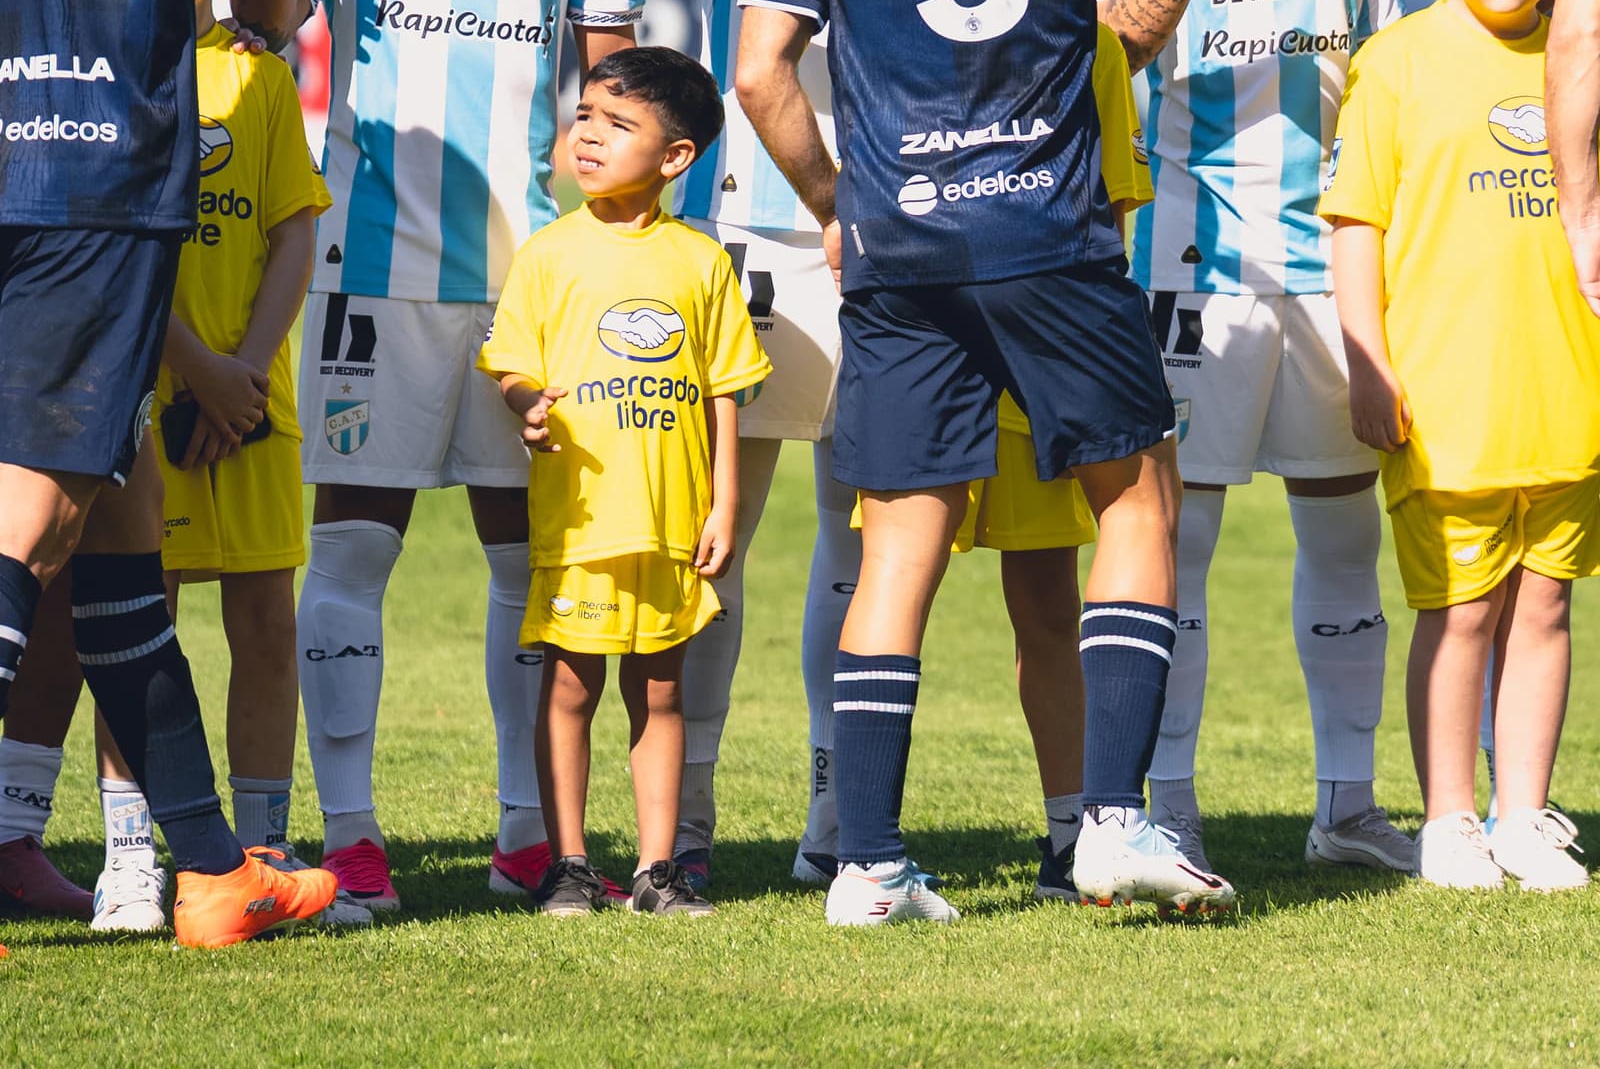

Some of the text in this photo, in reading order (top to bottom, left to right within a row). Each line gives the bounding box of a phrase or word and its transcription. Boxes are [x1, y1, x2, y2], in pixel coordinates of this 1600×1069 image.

[1201, 28, 1352, 63] RapiCuota
[0, 54, 115, 82] ANELLA
[5, 114, 118, 142] edelcos
[900, 117, 1054, 155] ZANELLA
[942, 169, 1054, 202] edelcos
[1468, 164, 1558, 193] merc
[1508, 192, 1559, 220] libr
[335, 366, 375, 377] RECOVERY
[577, 375, 699, 407] mercado
[617, 403, 676, 431] libre
[577, 611, 601, 621] libre
